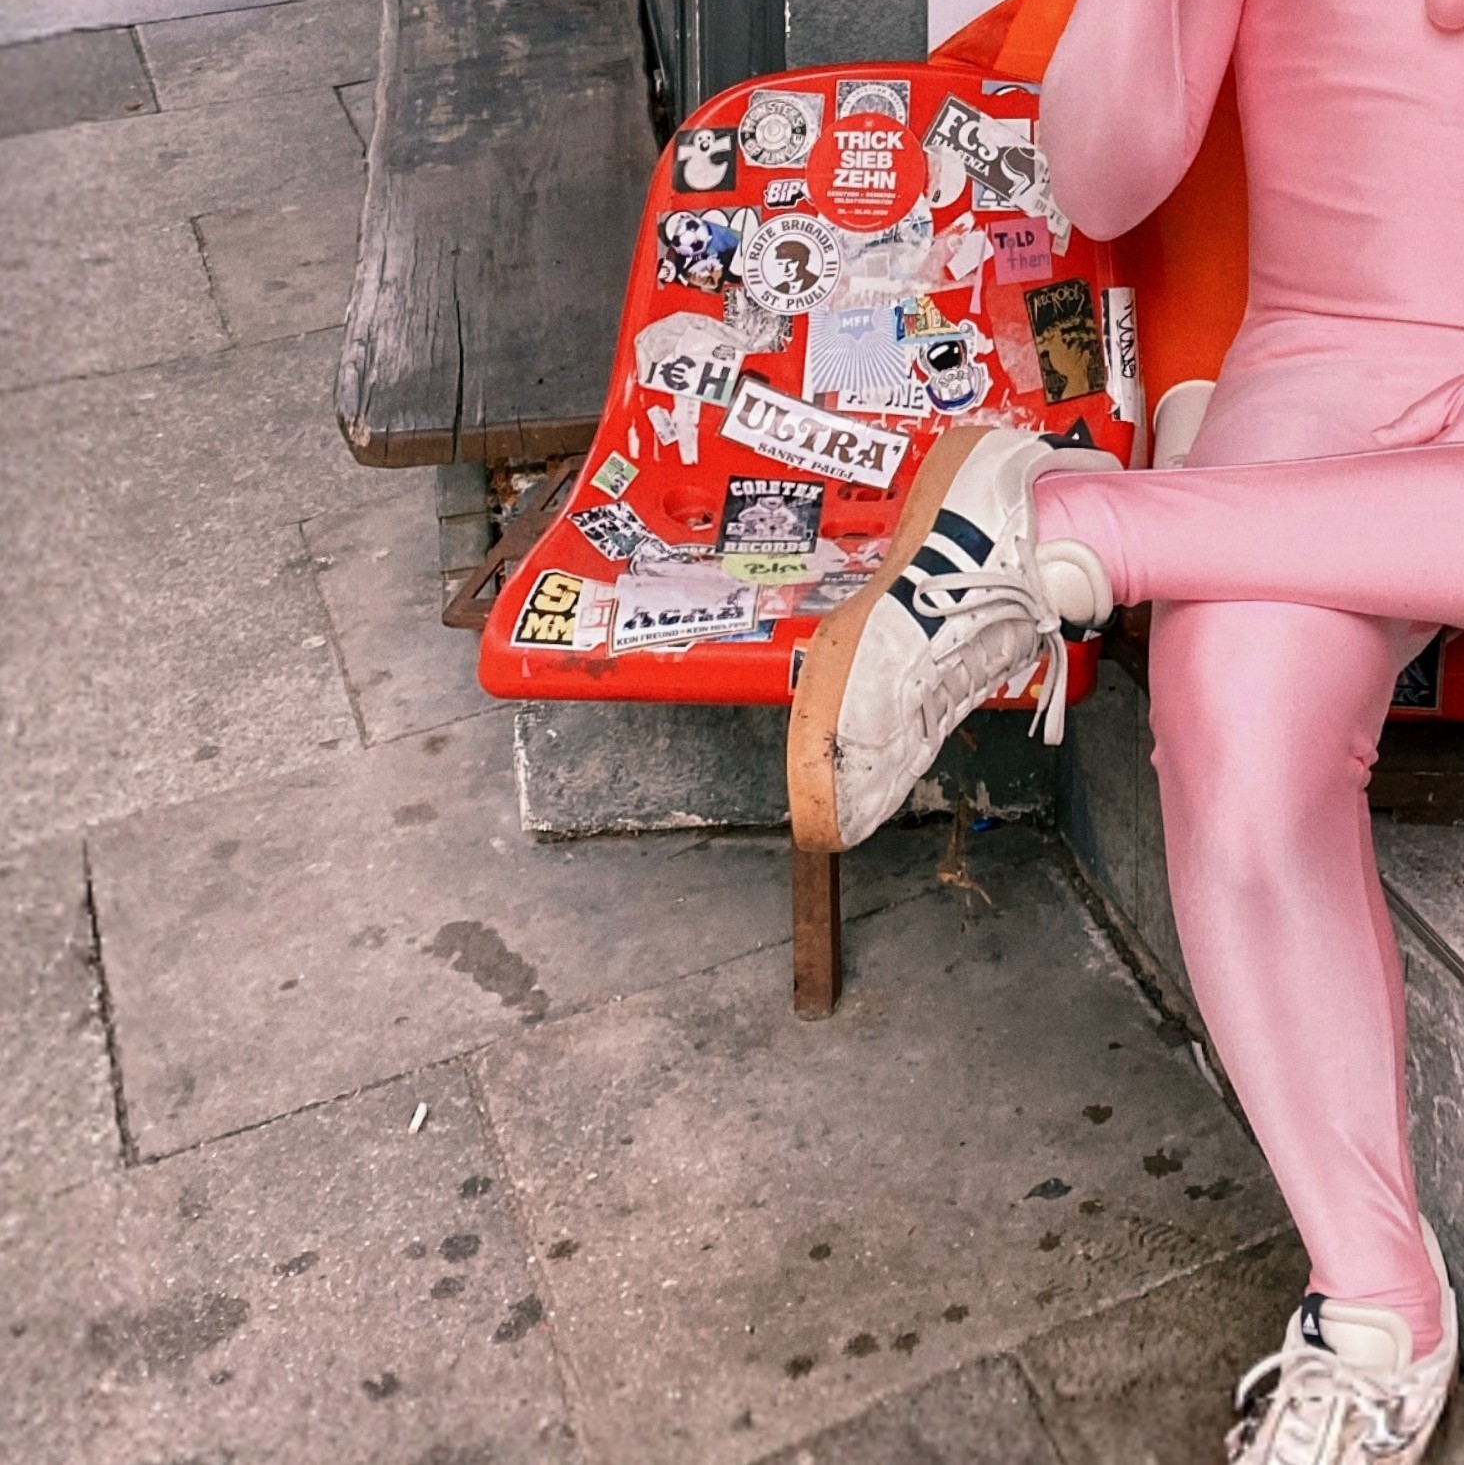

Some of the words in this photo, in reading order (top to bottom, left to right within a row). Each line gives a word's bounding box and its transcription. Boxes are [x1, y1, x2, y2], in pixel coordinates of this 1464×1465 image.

[833, 131, 904, 150] TRICK
[840, 151, 893, 169] SIEB
[832, 170, 897, 190] ZEHN
[749, 227, 777, 262] ROTE
[782, 219, 835, 254] BRIGADE
[786, 286, 827, 309] PAULI
[841, 316, 871, 328] MFF
[757, 442, 810, 469] SANKT
[811, 461, 854, 480] PAULI
[729, 481, 824, 500] CORETEX
[723, 541, 812, 553] RECORDS
[616, 636, 639, 646] KEIN
